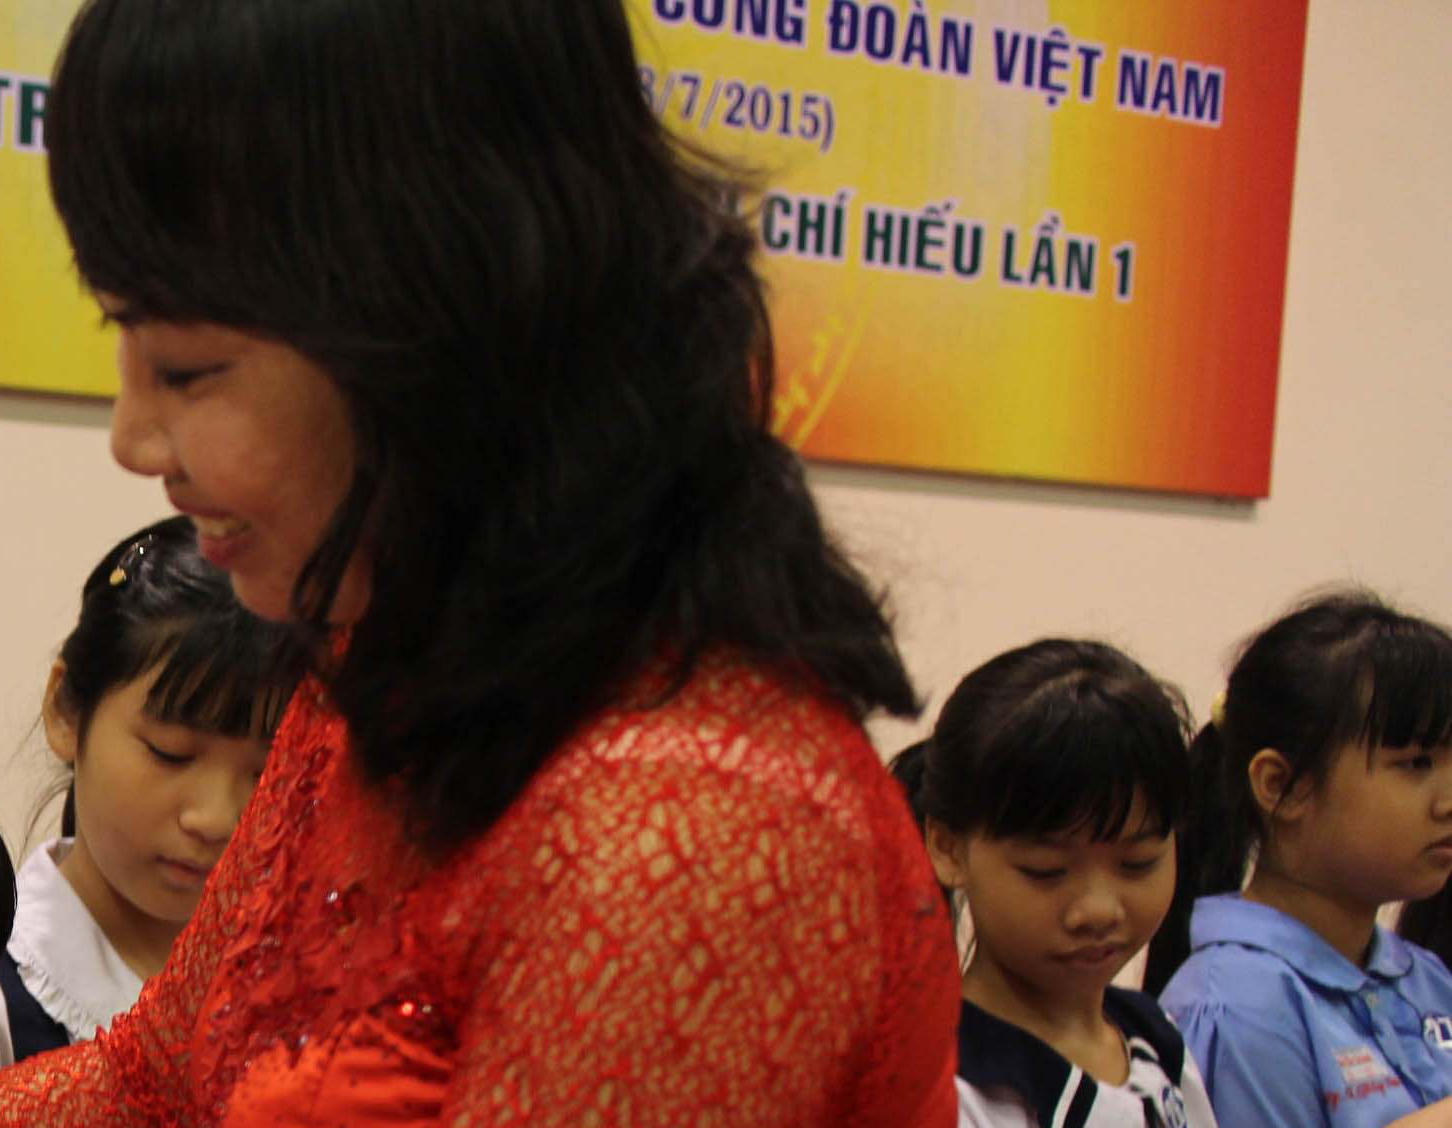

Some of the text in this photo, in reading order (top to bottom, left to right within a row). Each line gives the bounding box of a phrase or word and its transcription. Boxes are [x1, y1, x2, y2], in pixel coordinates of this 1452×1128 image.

[828, 0, 976, 78] ĐOÀN
[992, 27, 1104, 107] VIỆT
[1116, 53, 1224, 126] NAM
[761, 189, 853, 261] CHÍ
[862, 200, 985, 280] HIẾU
[1000, 211, 1096, 298] LẦN
[1110, 242, 1136, 301] 1
